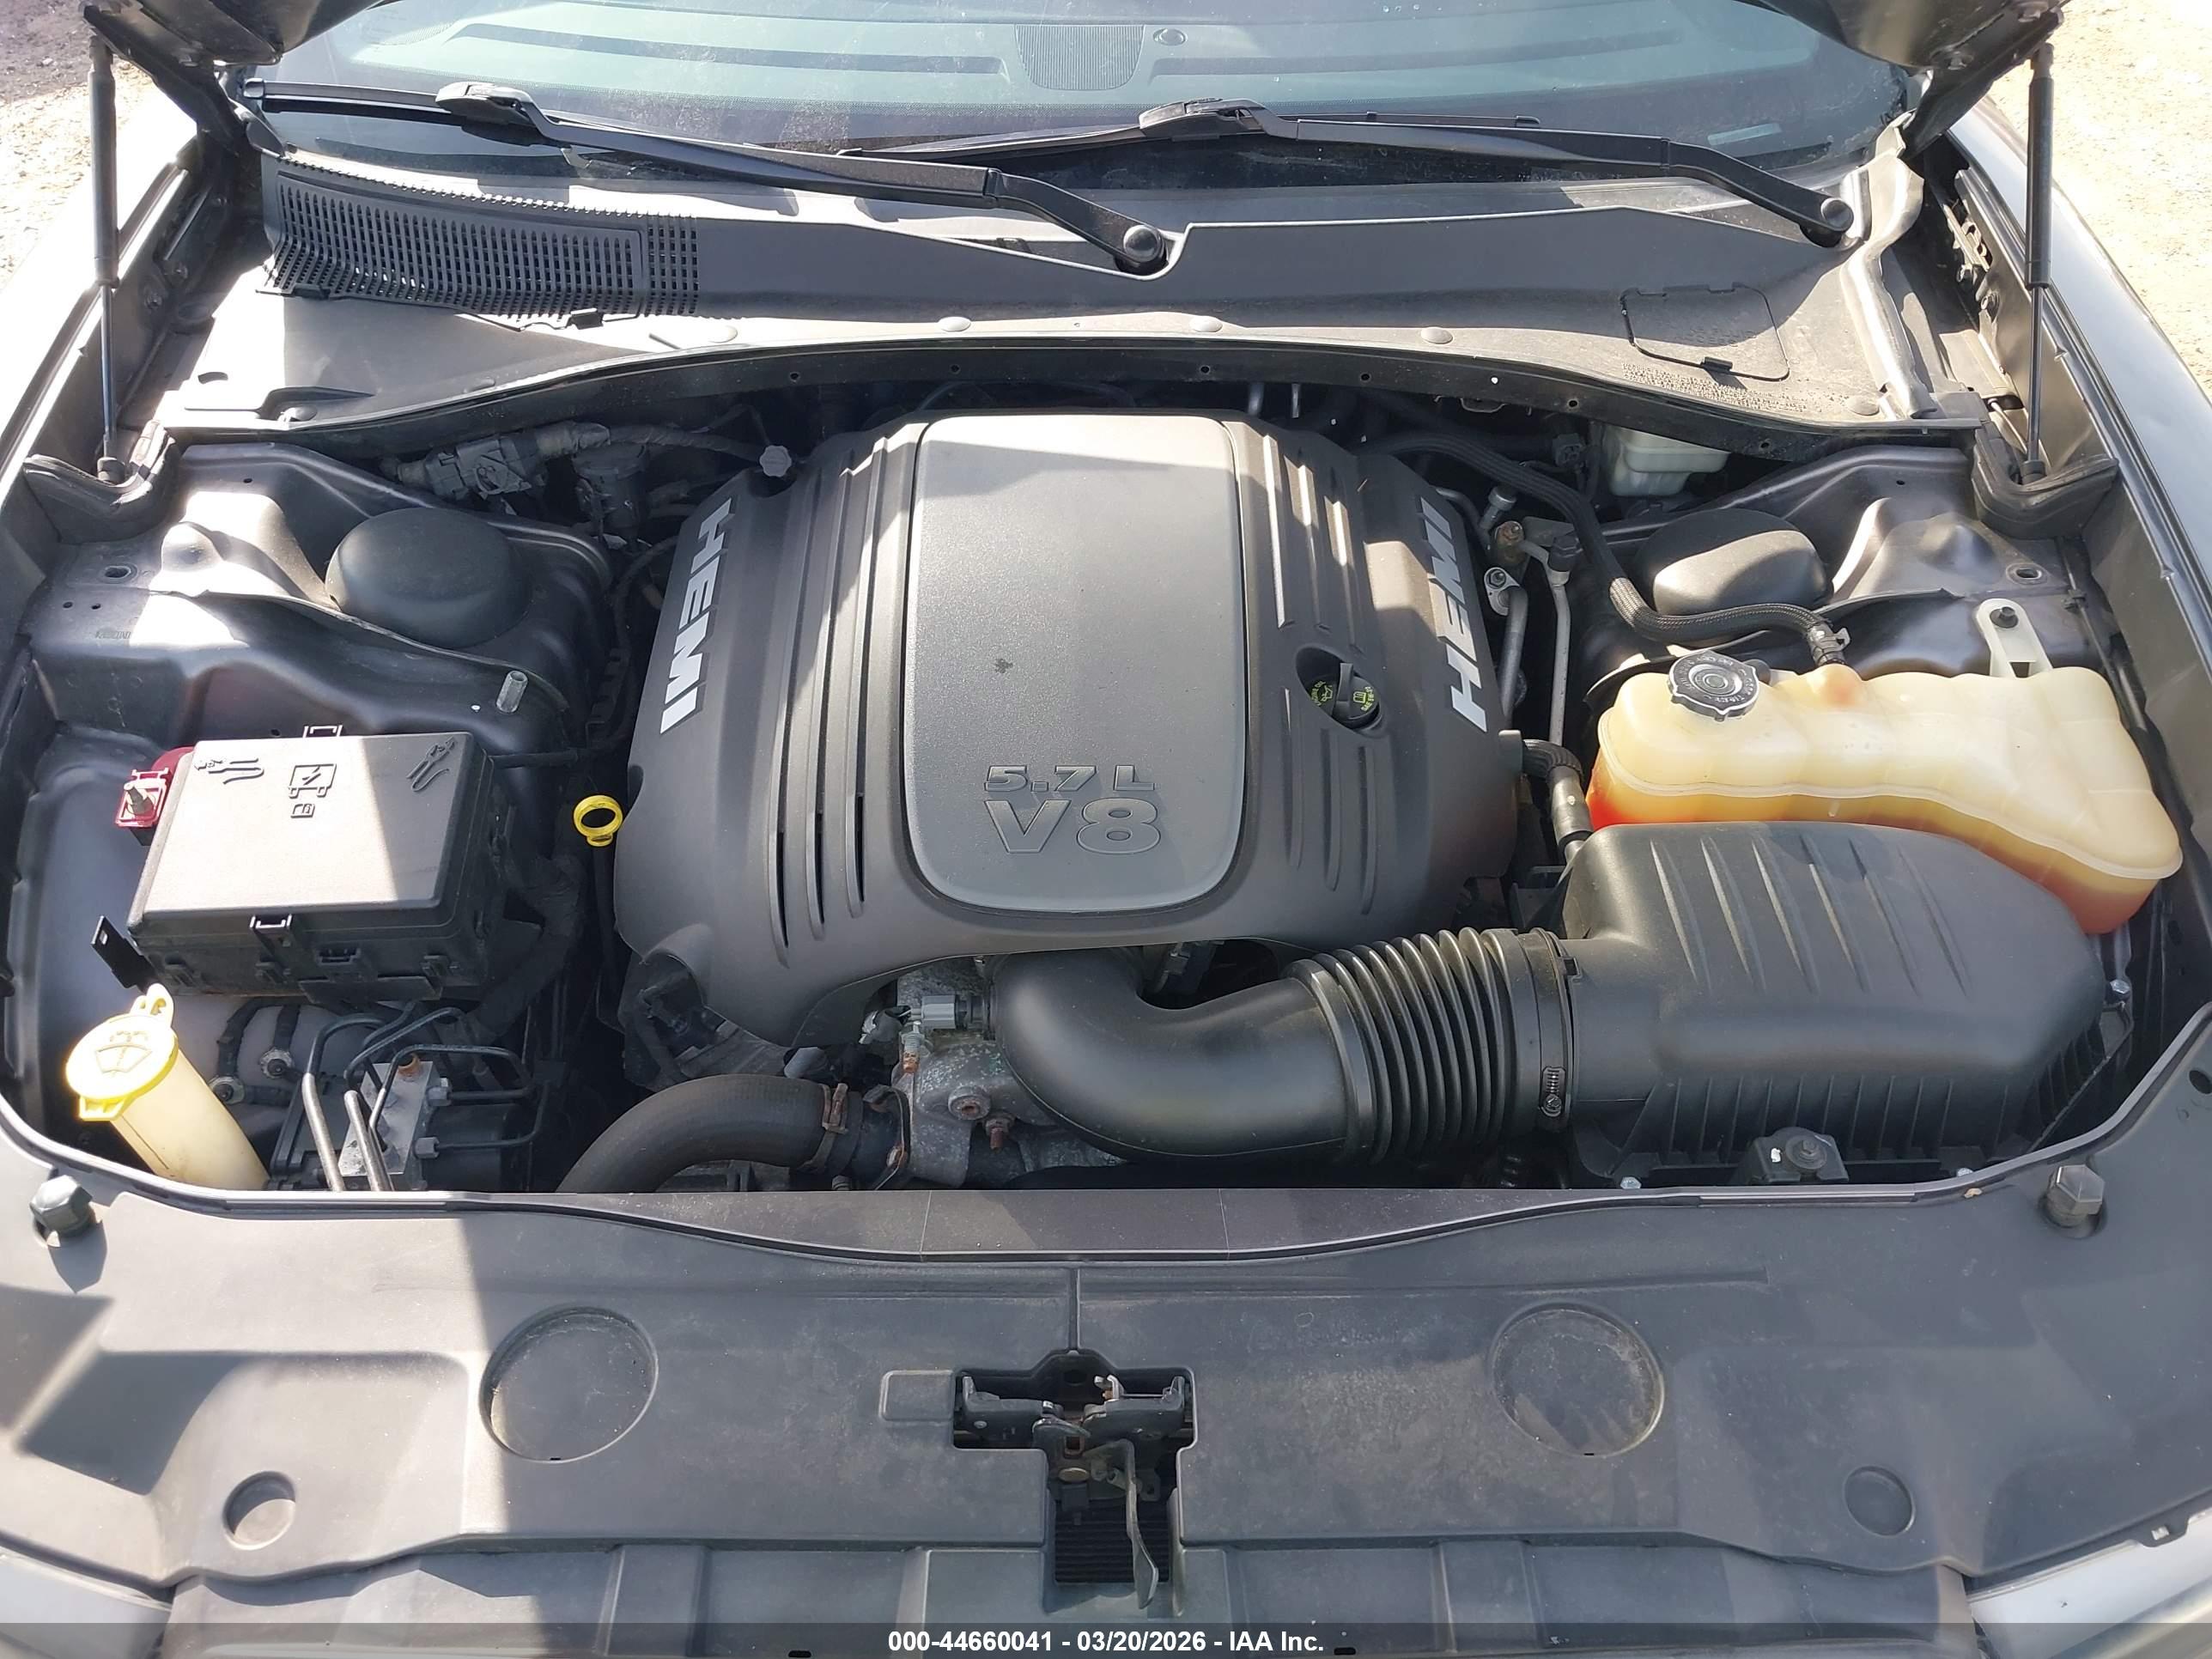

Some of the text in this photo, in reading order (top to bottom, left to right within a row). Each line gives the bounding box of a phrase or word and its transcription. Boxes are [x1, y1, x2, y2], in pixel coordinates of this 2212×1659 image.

[659, 497, 732, 735] HEMI
[1420, 496, 1488, 732] HEMI
[984, 798, 1161, 854] V8
